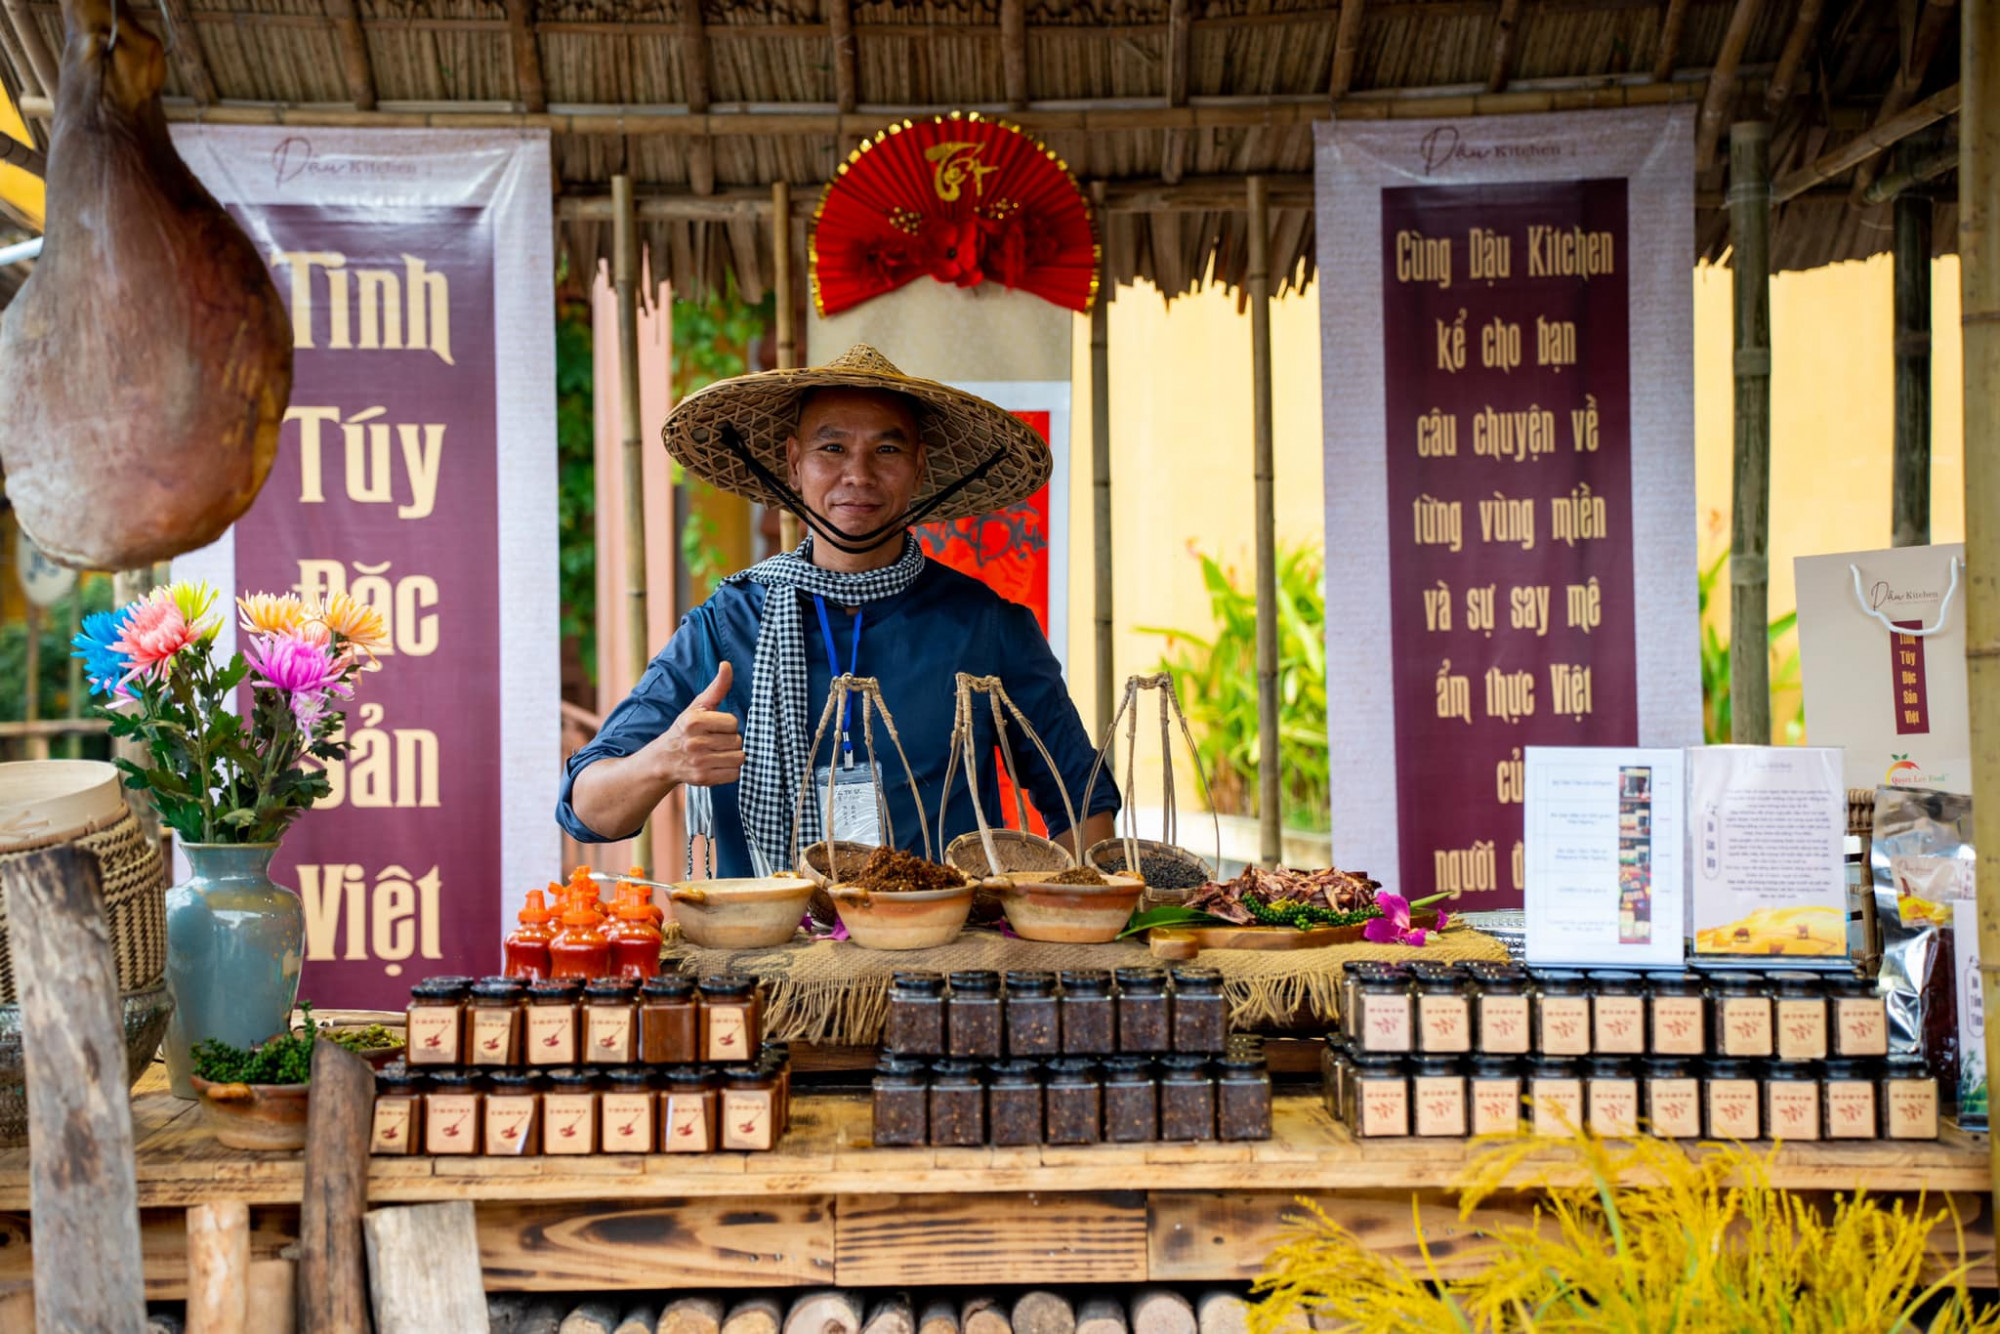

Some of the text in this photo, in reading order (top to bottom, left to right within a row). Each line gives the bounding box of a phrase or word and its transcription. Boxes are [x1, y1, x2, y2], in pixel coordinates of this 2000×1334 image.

[1494, 144, 1561, 159] Kitchen
[1396, 225, 1614, 289] Cùng Dậu Kitchen
[270, 251, 455, 366] Tinh
[1436, 308, 1576, 374] kể cho bạn
[1416, 393, 1599, 463] câu chuyện về
[283, 405, 447, 520] Túy
[1413, 481, 1607, 553] từng vùng miền
[1423, 576, 1602, 638] và sự say mê
[1906, 590, 1939, 600] Kitchen
[1436, 658, 1593, 725] ẩm thực Việt
[1496, 747, 1524, 804] củ
[1433, 839, 1497, 901] người
[296, 864, 443, 977] Việt
